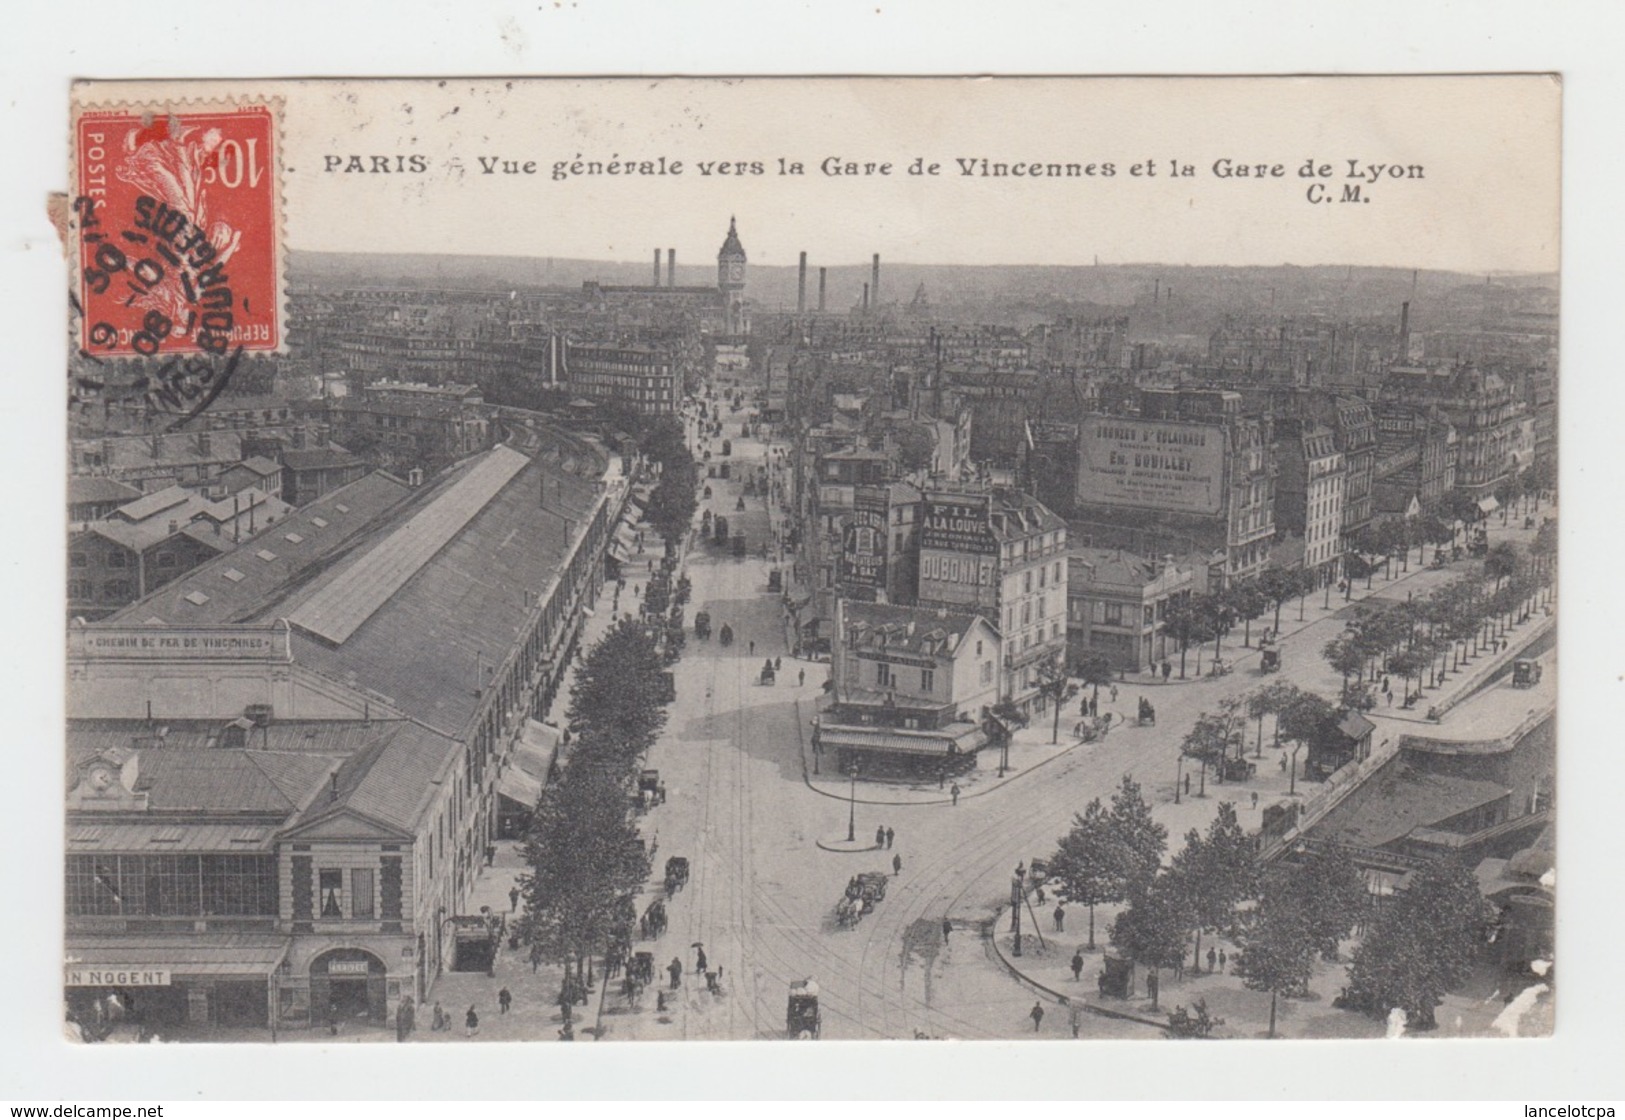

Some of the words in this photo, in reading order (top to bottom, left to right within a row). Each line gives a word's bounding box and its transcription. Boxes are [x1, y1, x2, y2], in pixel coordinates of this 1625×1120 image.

[88, 132, 106, 209] POSTES
[933, 505, 977, 518] FIL
[923, 516, 931, 529] A
[934, 516, 947, 530] LA
[949, 518, 986, 534] LOUVE
[860, 567, 877, 577] GAZ
[922, 555, 995, 587] DUBONNET
[95, 638, 138, 648] CHEMIN
[141, 638, 155, 648] DE
[160, 638, 179, 648] FER
[184, 638, 198, 648] DE
[202, 638, 262, 649] VINCENNES
[89, 971, 164, 985] NOGENT
